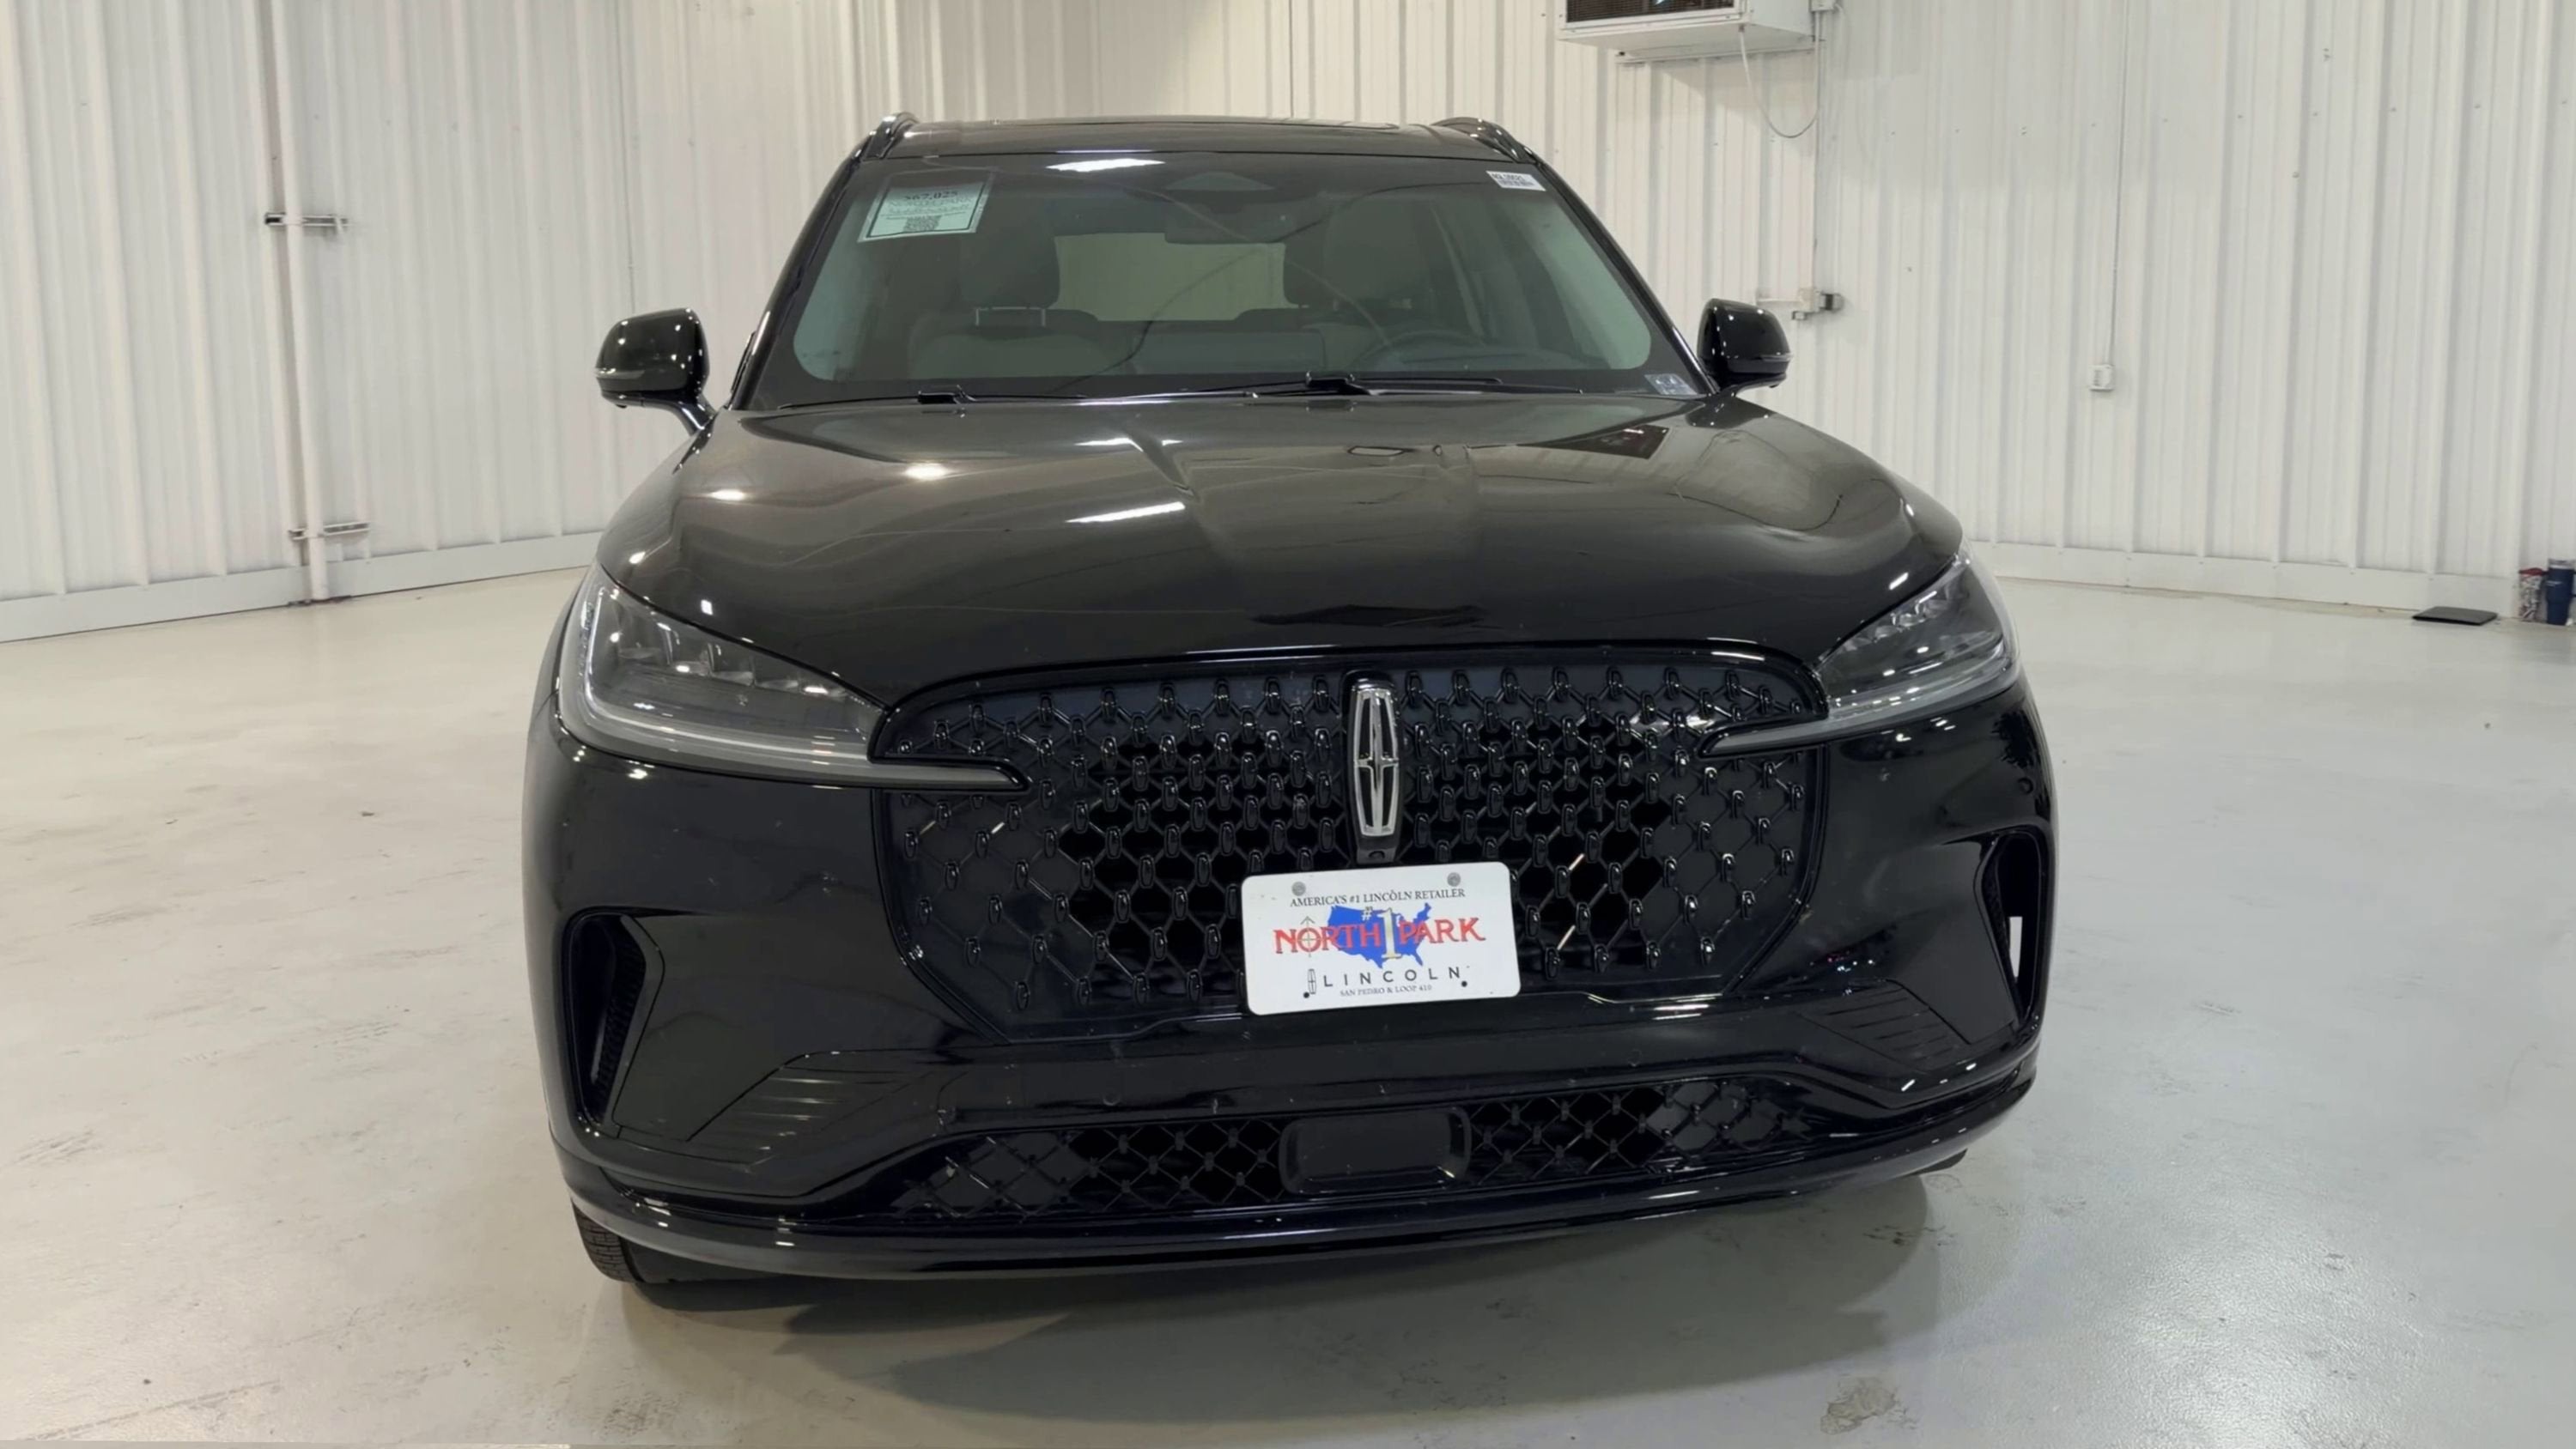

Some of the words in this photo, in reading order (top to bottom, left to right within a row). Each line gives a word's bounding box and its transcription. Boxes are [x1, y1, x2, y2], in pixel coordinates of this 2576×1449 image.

[1290, 894, 1347, 907] AMERICA'S
[1349, 895, 1360, 904] #1
[1364, 890, 1413, 903] LINCOLN
[1415, 888, 1466, 900] RETAILER
[1273, 922, 1382, 955] NORTH
[1398, 917, 1486, 946] PARK
[1323, 967, 1460, 987] LINCOLN
[1340, 989, 1356, 997] SAN
[1358, 986, 1385, 996] PEDRO
[1395, 985, 1417, 993] LOOP
